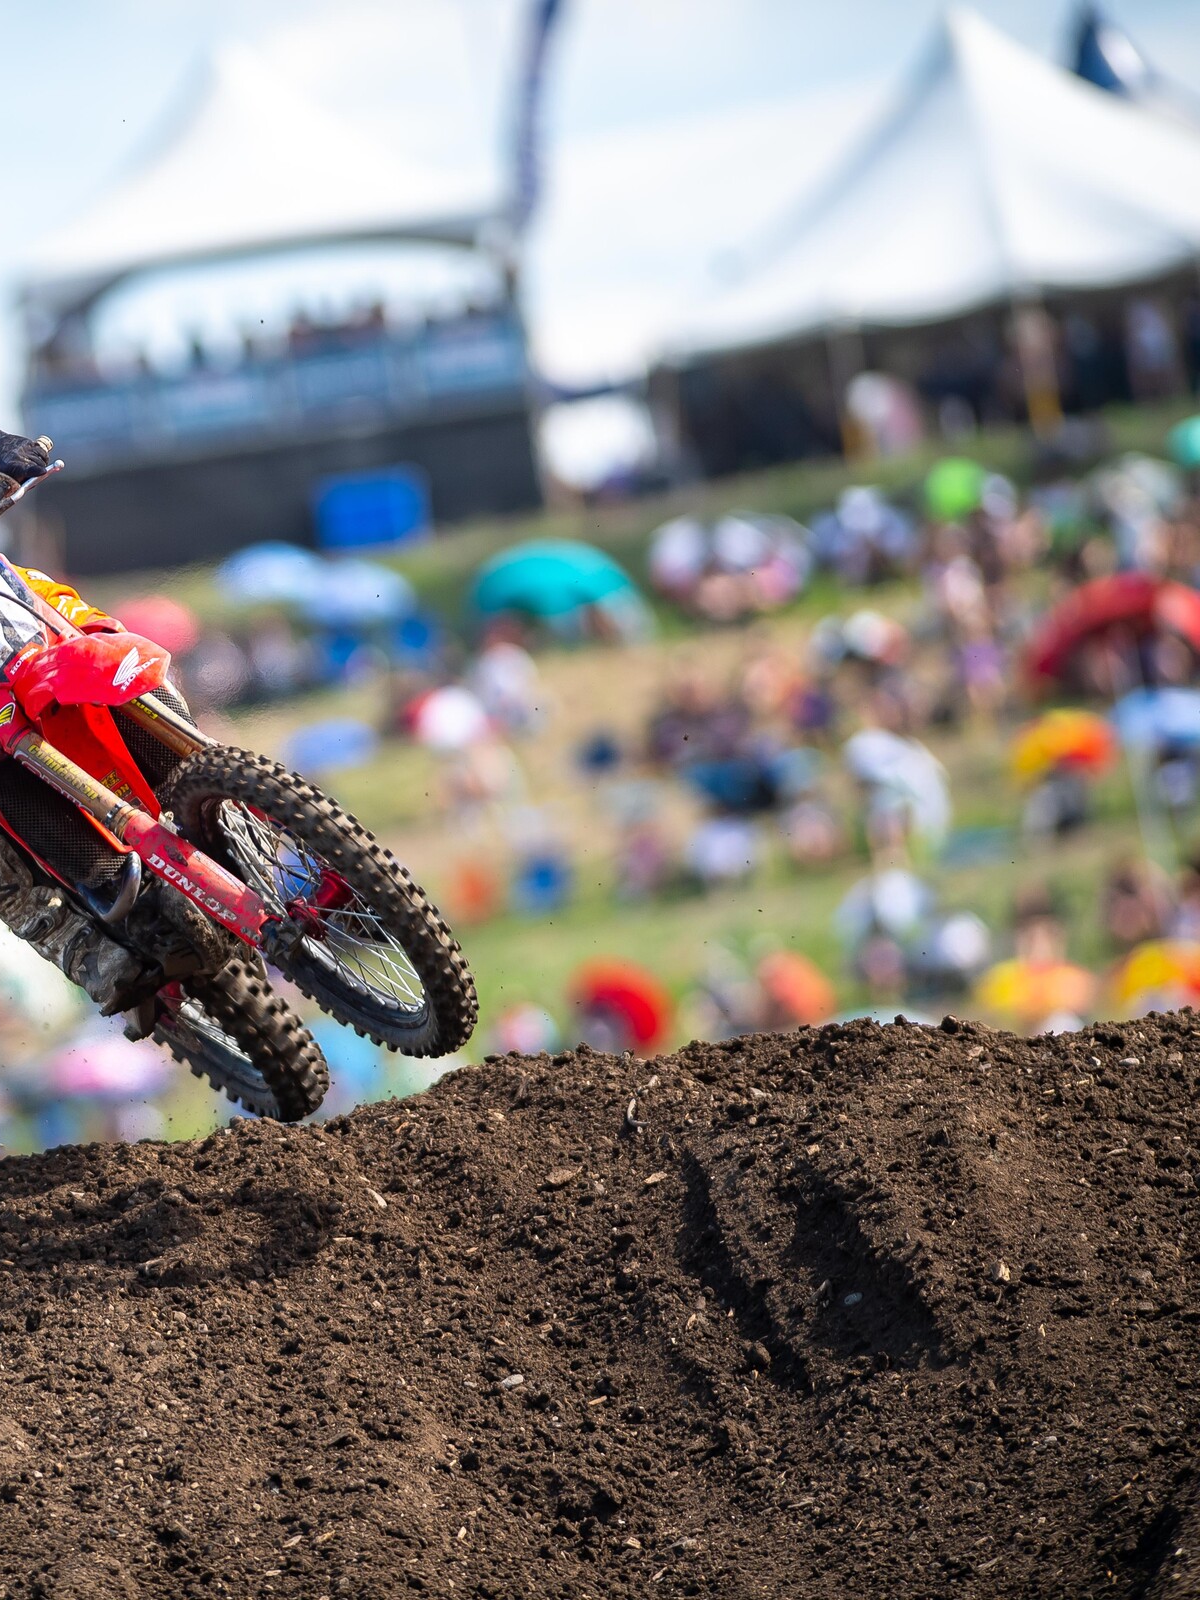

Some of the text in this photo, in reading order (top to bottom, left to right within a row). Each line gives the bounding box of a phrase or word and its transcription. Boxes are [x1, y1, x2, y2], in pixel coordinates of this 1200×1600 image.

[9, 647, 39, 676] HONDA
[120, 657, 160, 692] HONDA
[146, 853, 237, 921] DUNLOP
